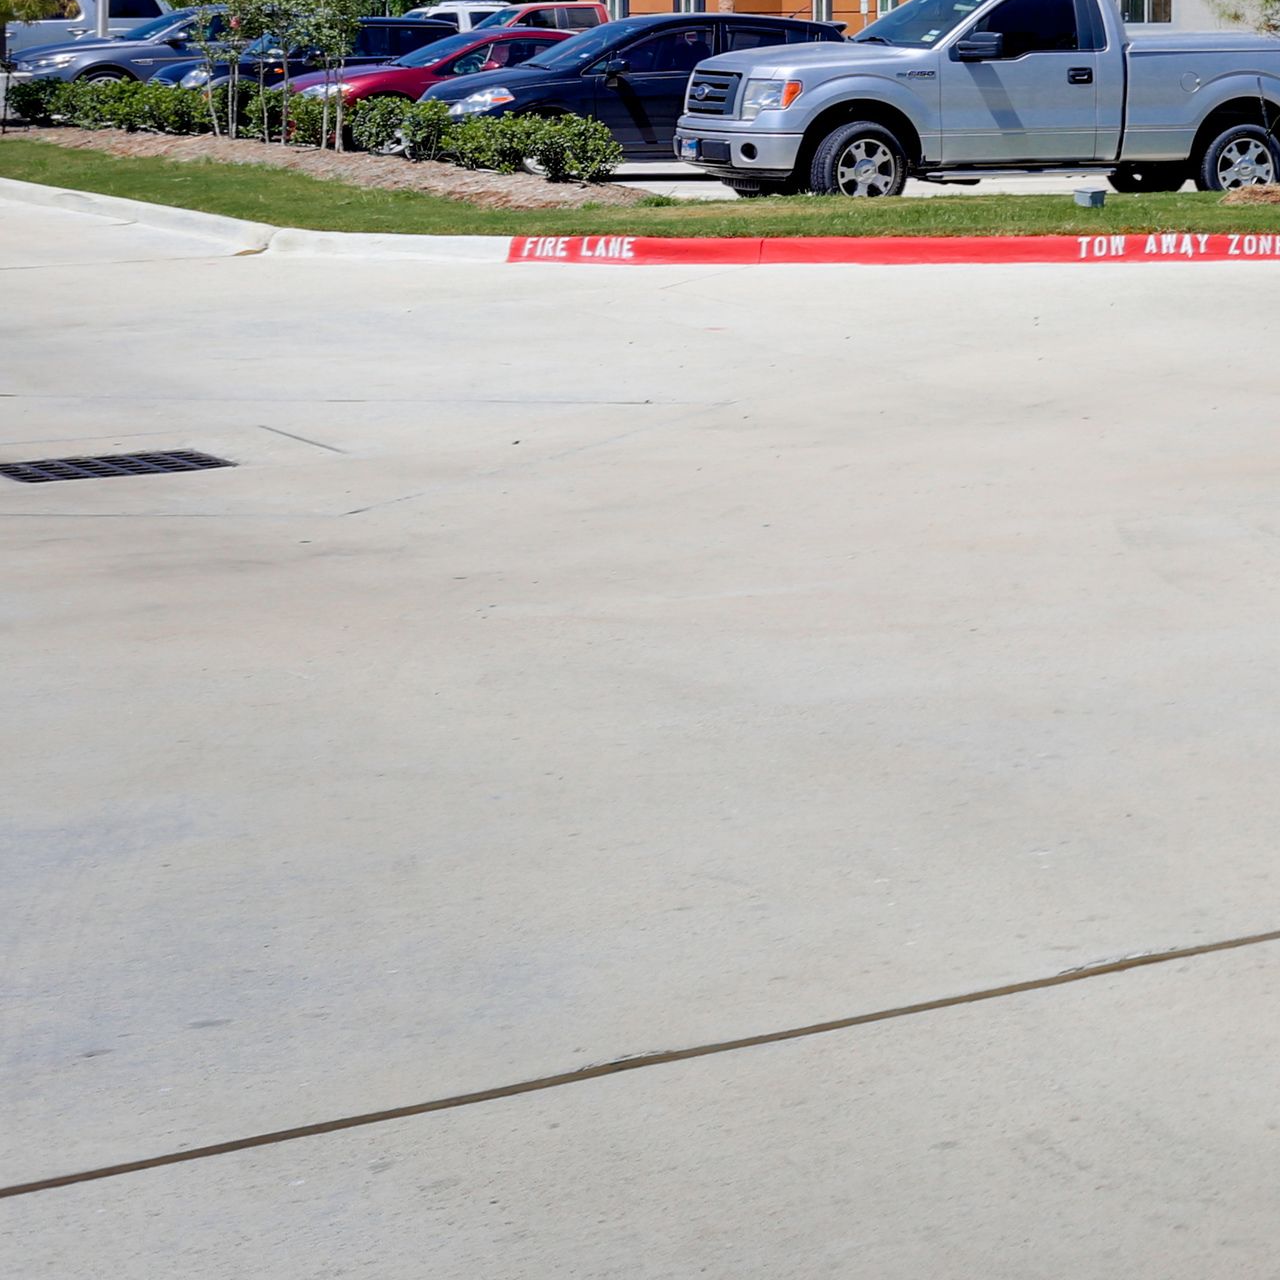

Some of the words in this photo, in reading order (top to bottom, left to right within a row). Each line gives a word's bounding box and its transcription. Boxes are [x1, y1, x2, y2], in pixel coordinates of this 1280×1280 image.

[522, 237, 570, 257] FIRE
[581, 237, 636, 258] LANE
[1077, 235, 1126, 258] TOW
[1144, 233, 1209, 258] AWAY
